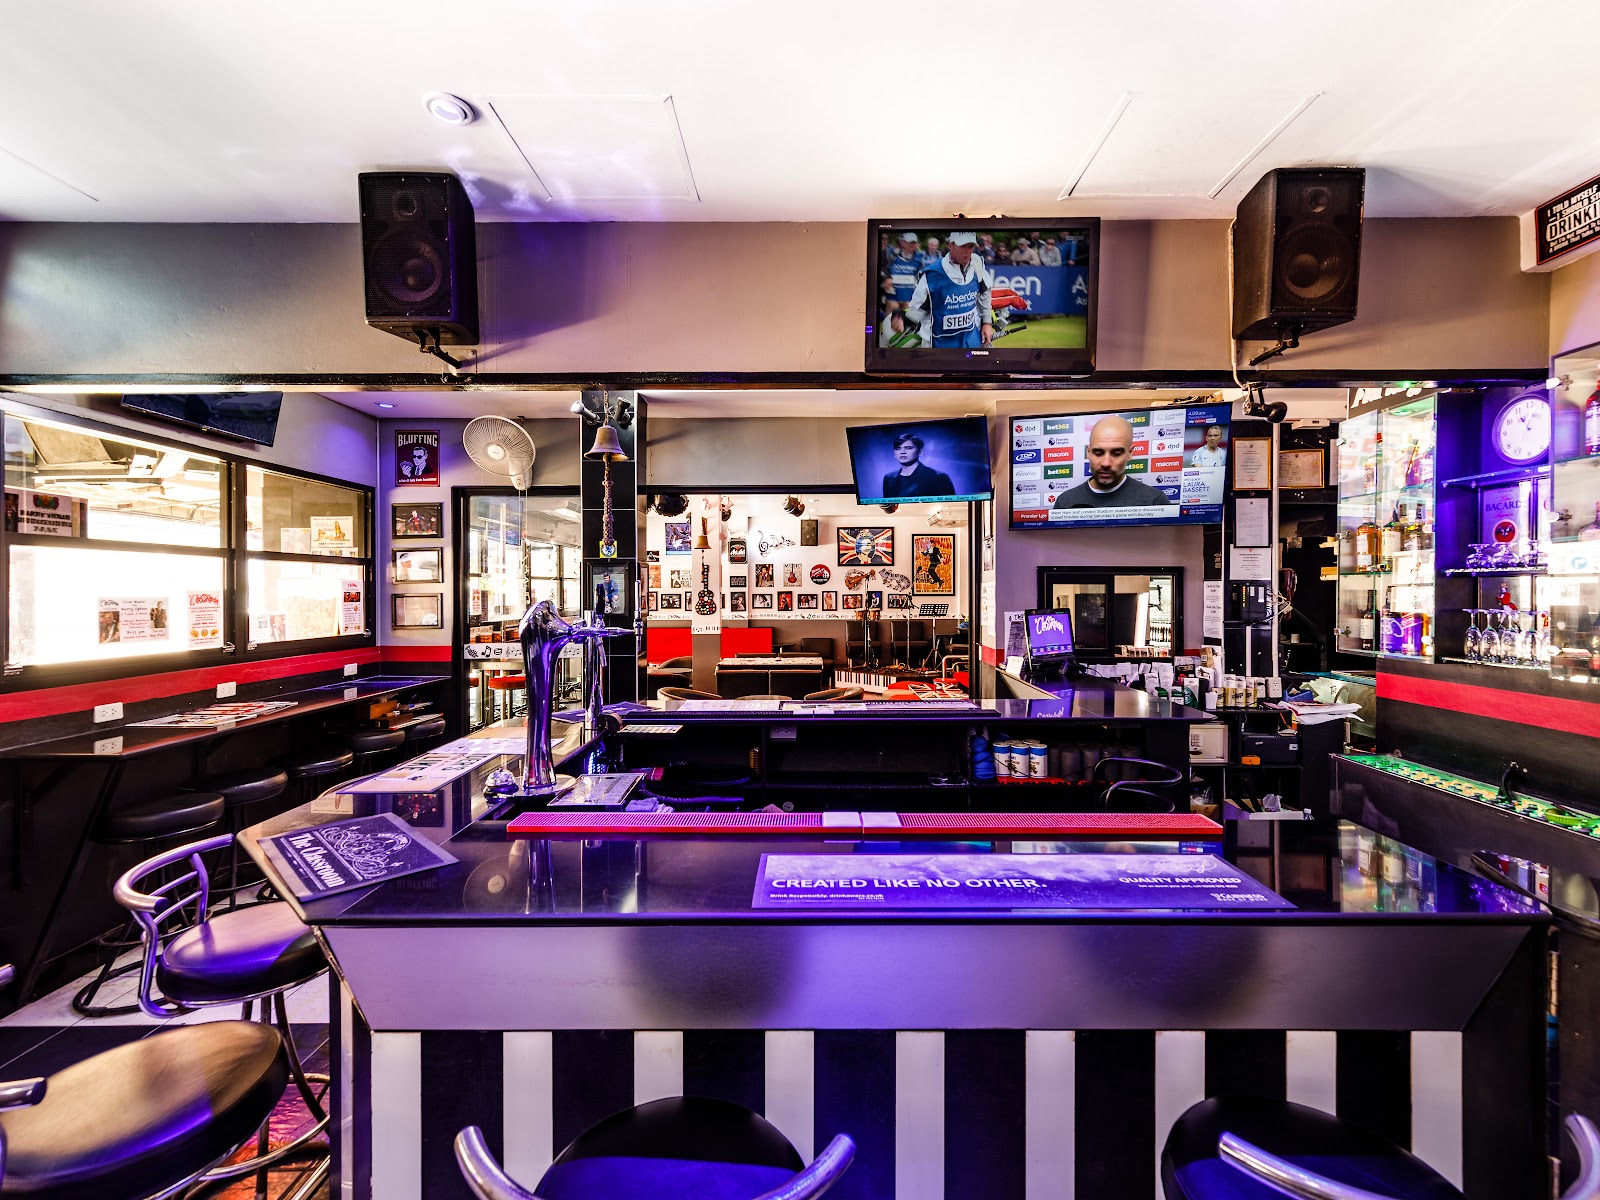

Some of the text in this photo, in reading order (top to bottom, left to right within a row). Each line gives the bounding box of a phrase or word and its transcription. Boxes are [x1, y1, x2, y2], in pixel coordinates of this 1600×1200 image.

[1570, 184, 1598, 205] MYSELF
[1549, 203, 1598, 241] DRINKI
[1525, 401, 1535, 409] 12
[1126, 416, 1146, 424] et365
[1024, 425, 1036, 433] dpd
[1046, 423, 1070, 431] bet365
[397, 434, 438, 448] BLUFFING
[1485, 500, 1523, 512] BACARD
[288, 833, 315, 849] The
[300, 846, 346, 888] Classroom
[771, 878, 1048, 889] CREATED LIKE NO OTHER.
